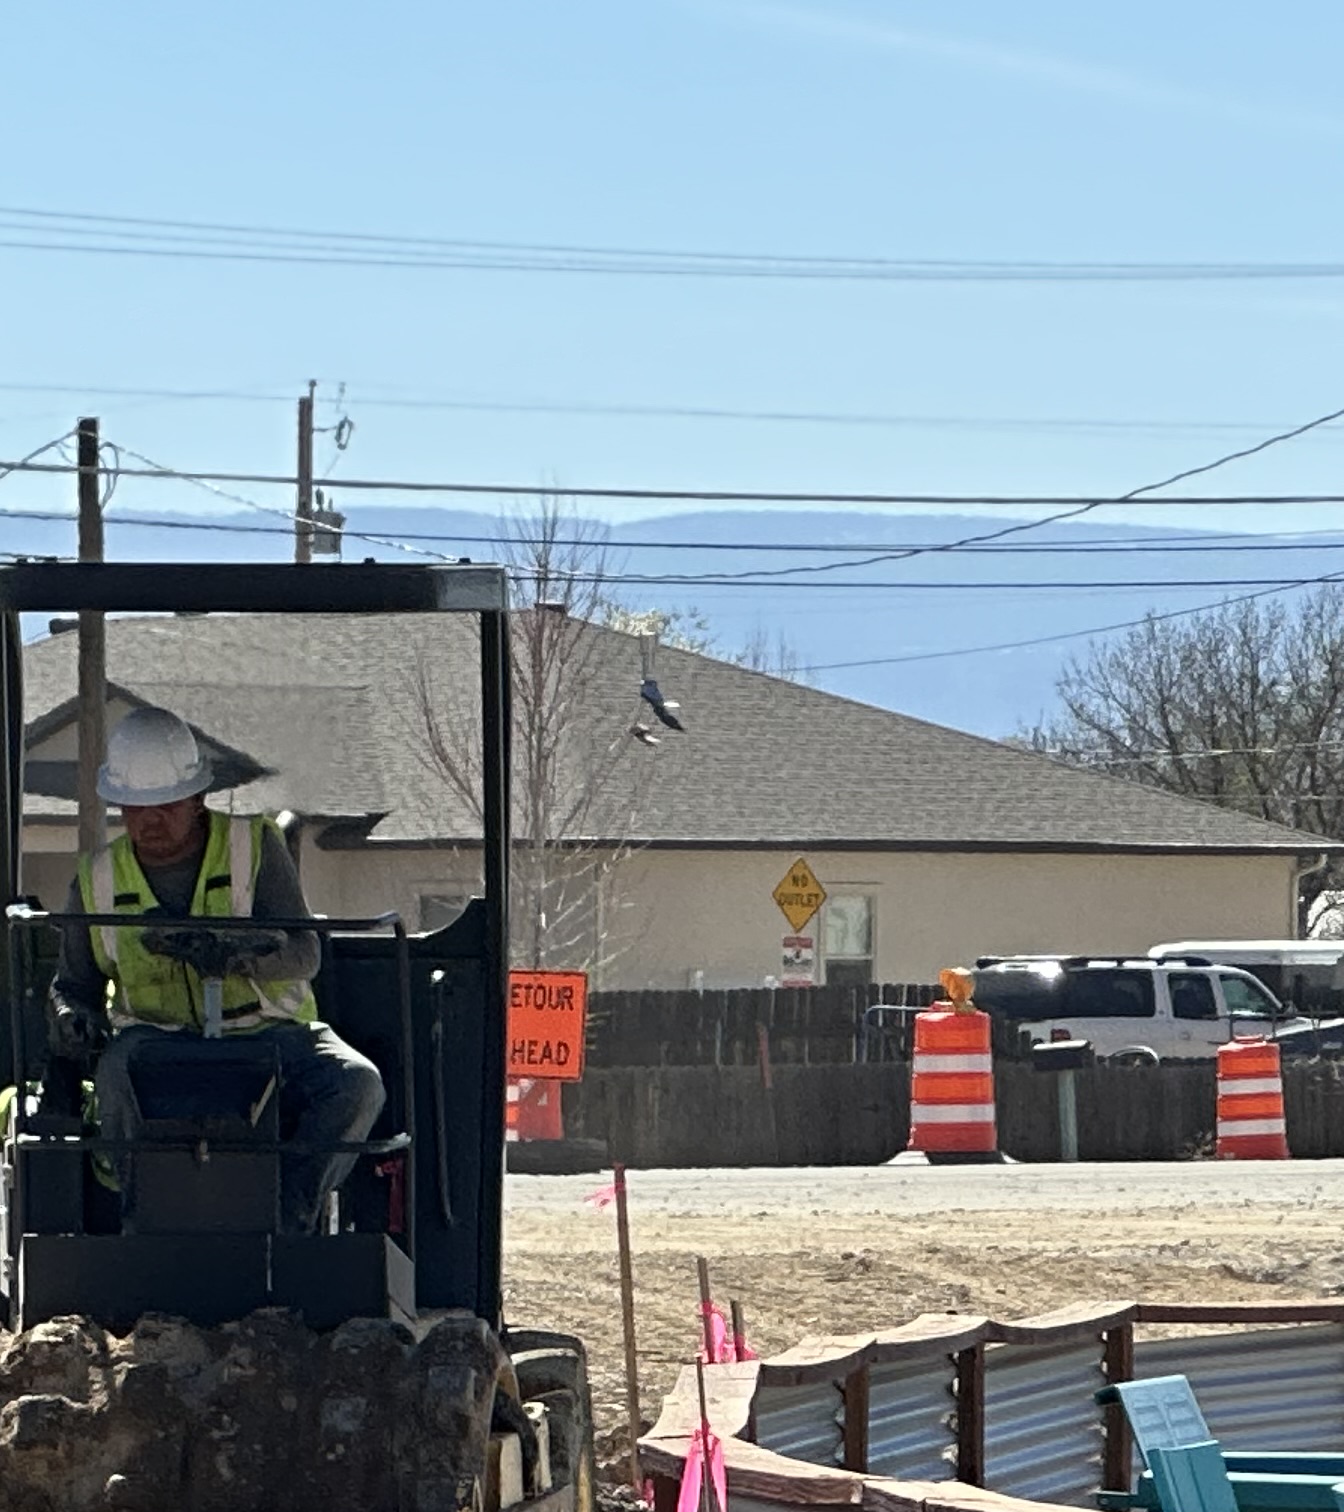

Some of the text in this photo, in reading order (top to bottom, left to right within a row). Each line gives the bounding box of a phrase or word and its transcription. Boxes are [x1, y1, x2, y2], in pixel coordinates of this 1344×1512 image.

[791, 873, 809, 889] NO
[510, 983, 574, 1011] ETOUR
[511, 1039, 571, 1065] HEAD
